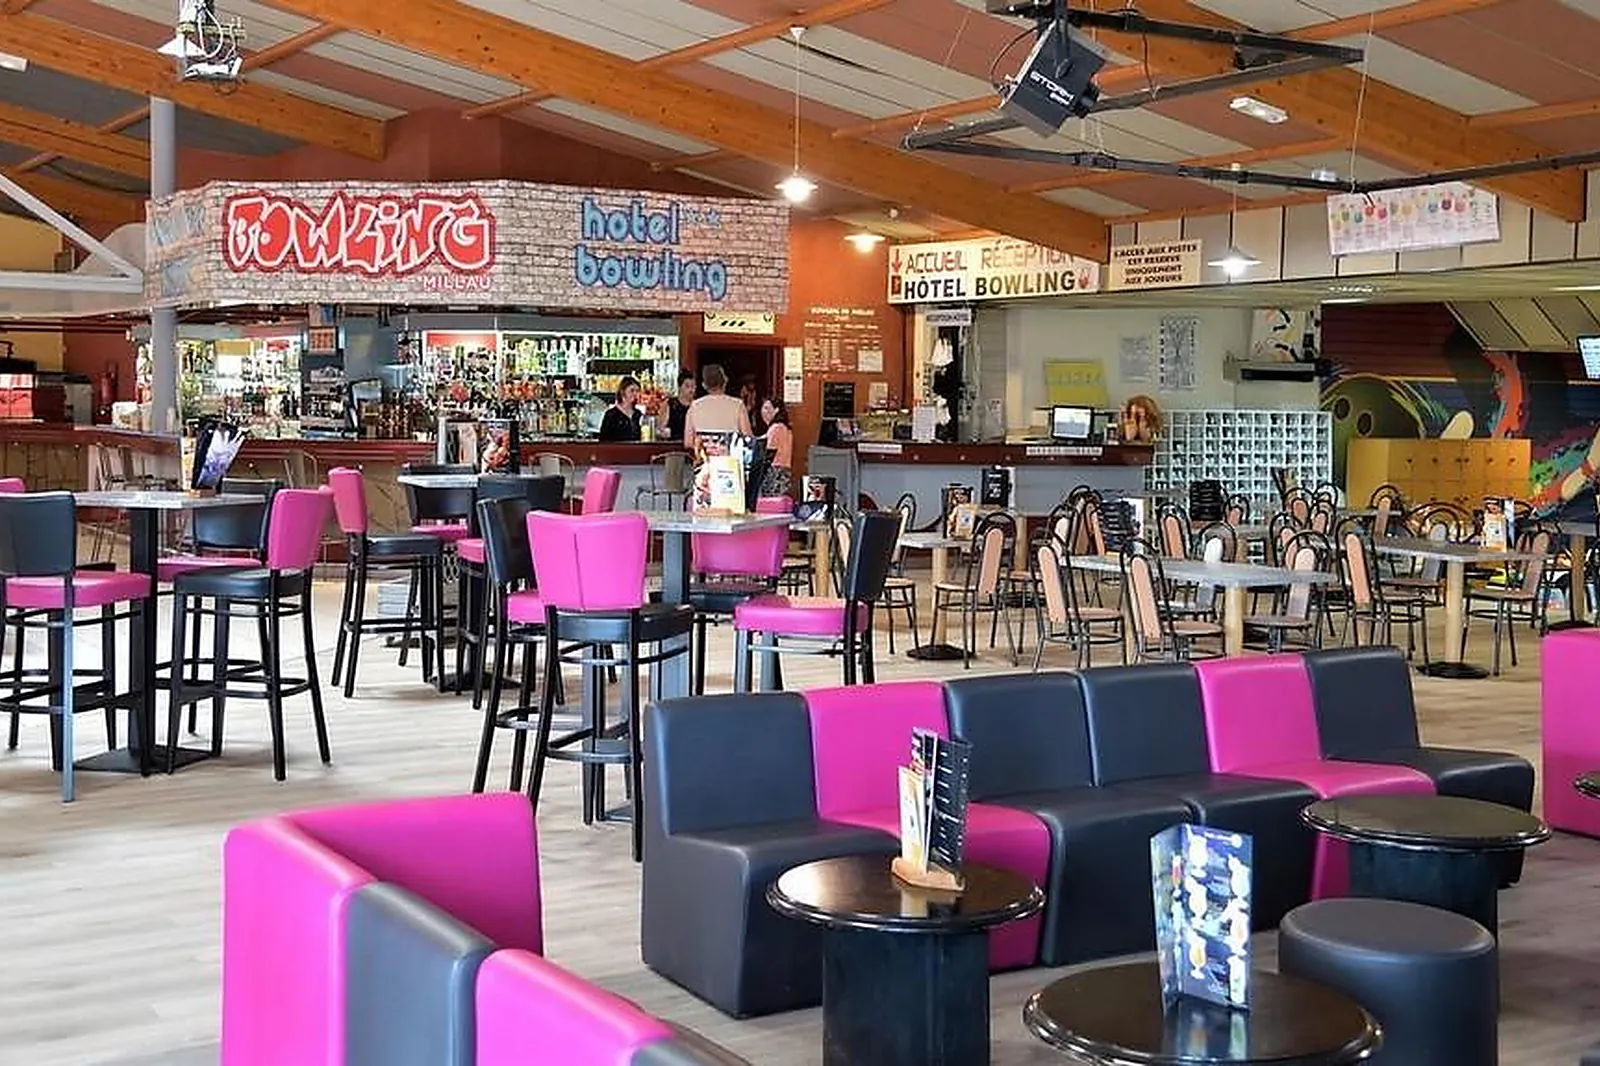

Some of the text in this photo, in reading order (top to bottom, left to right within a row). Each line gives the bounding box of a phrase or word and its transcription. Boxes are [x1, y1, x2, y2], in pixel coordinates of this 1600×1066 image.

[581, 197, 680, 245] hotel
[224, 191, 494, 275] BOWLING
[1146, 245, 1167, 255] AUX
[1168, 244, 1197, 254] PISTES
[905, 250, 968, 274] ACCUEIL
[1124, 264, 1182, 275] UNIQUEMENT
[1127, 257, 1142, 266] EST
[574, 244, 727, 300] bowling
[1124, 274, 1183, 285] AUX JOUEURS
[421, 275, 491, 291] MILLAU
[904, 270, 1075, 300] HÔTEL BOWLING
